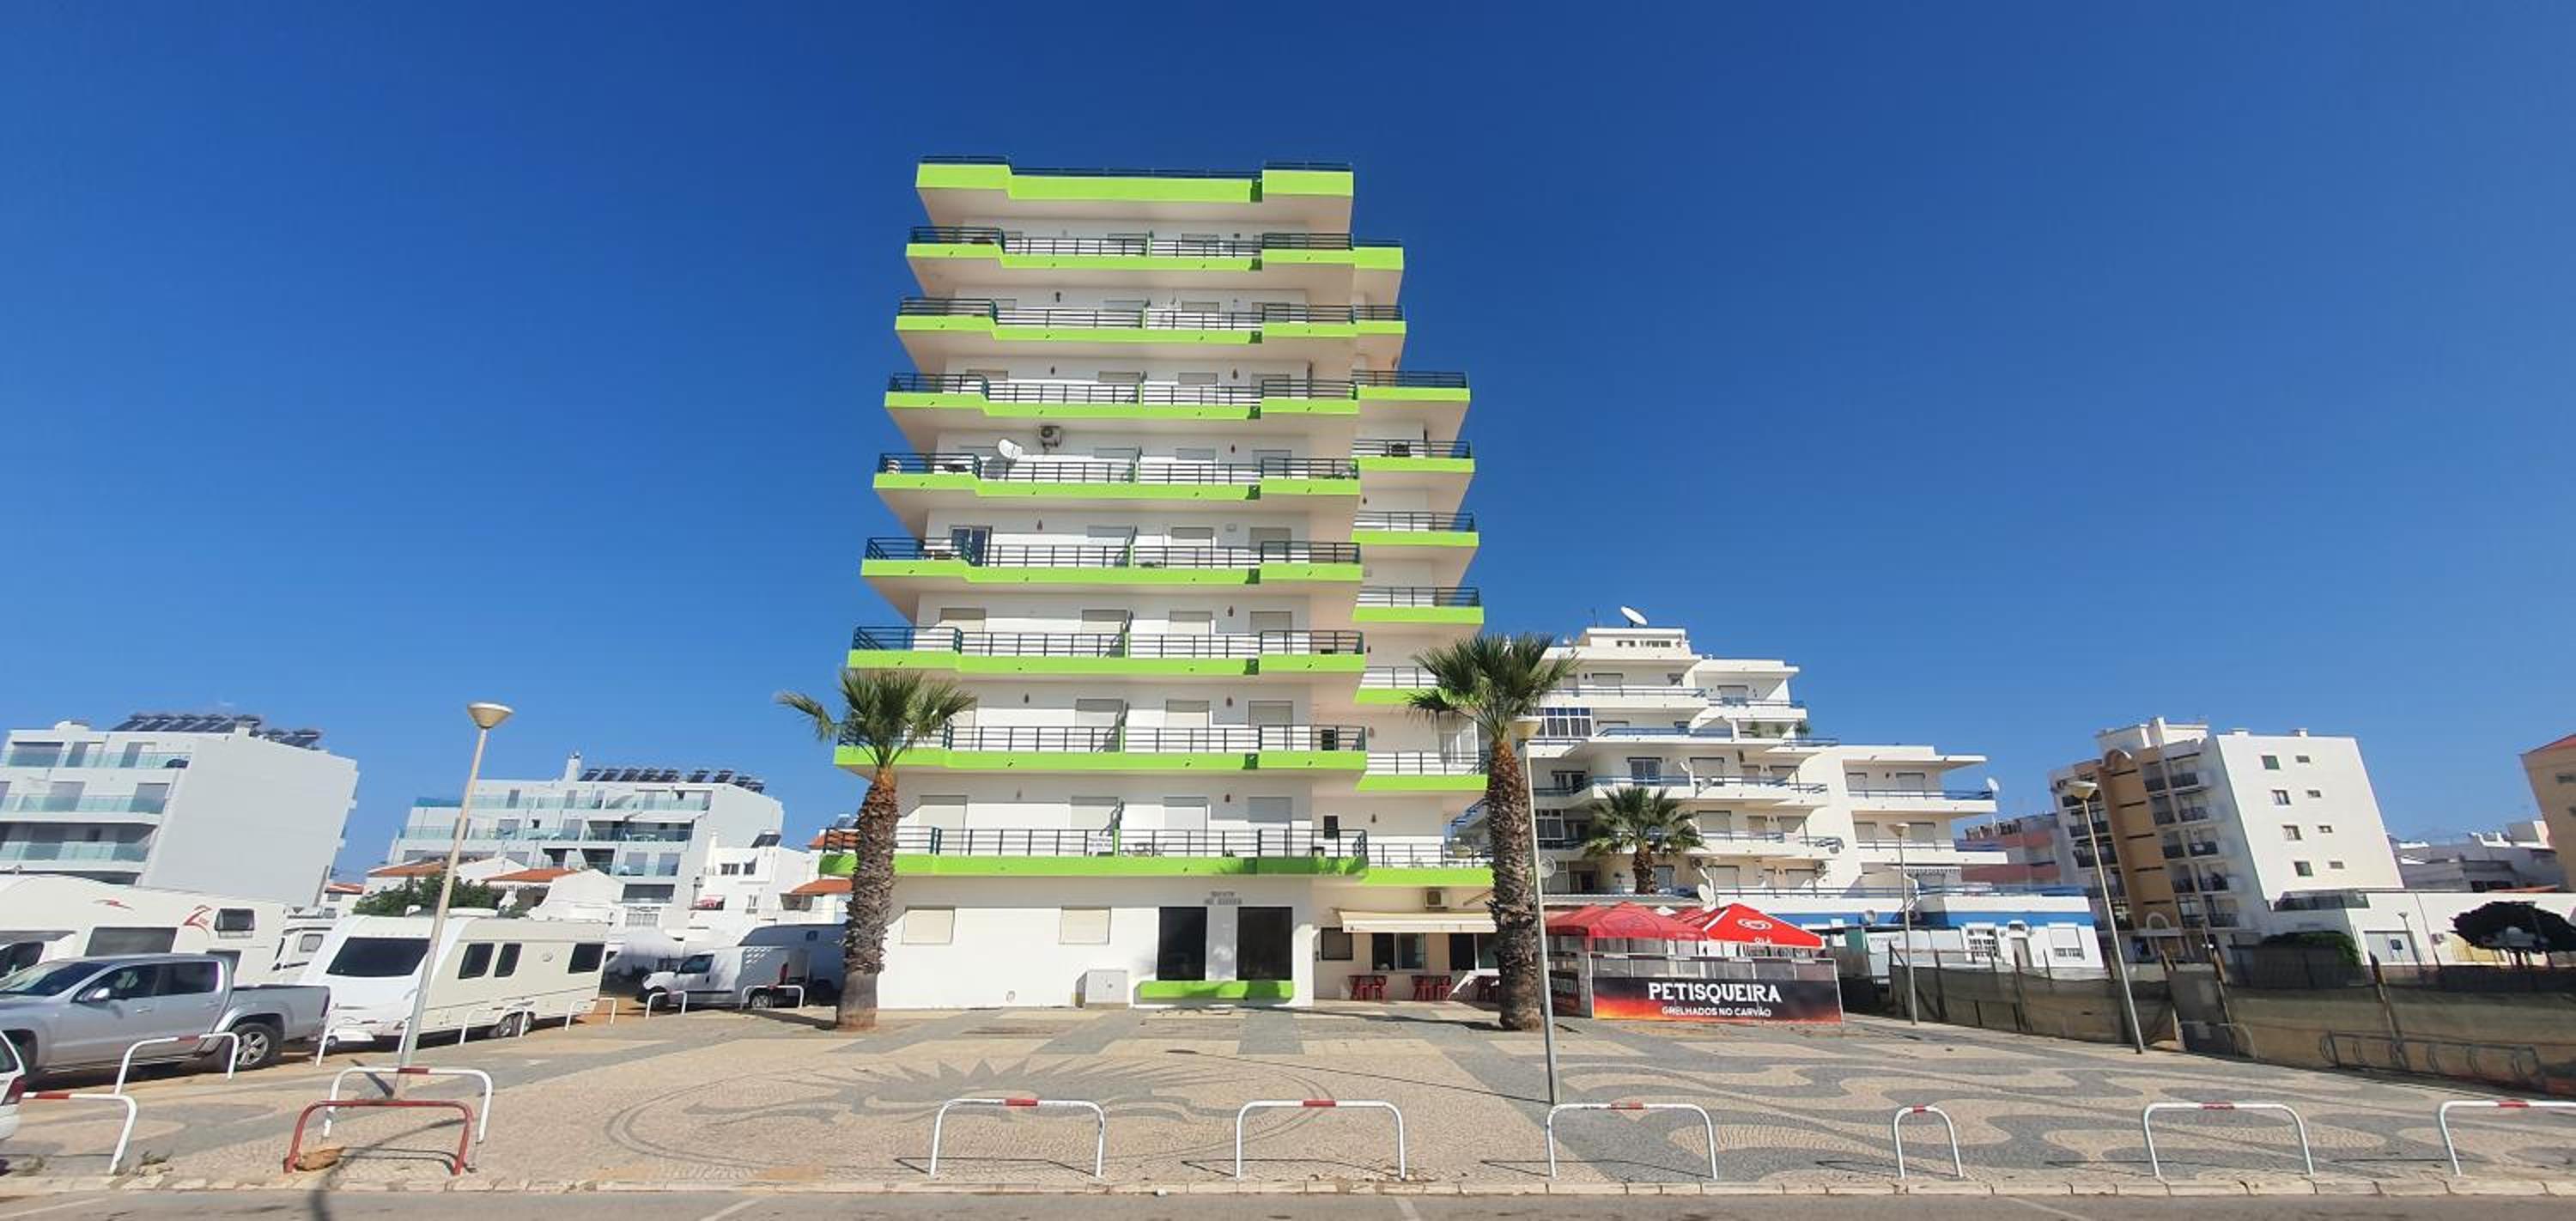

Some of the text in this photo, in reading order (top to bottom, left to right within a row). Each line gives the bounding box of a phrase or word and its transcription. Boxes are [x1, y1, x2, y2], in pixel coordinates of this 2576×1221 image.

[1648, 982, 1783, 1004] PETISQUEIRA
[1662, 1006, 1771, 1017] GRELHADOS NO CARVÃO
